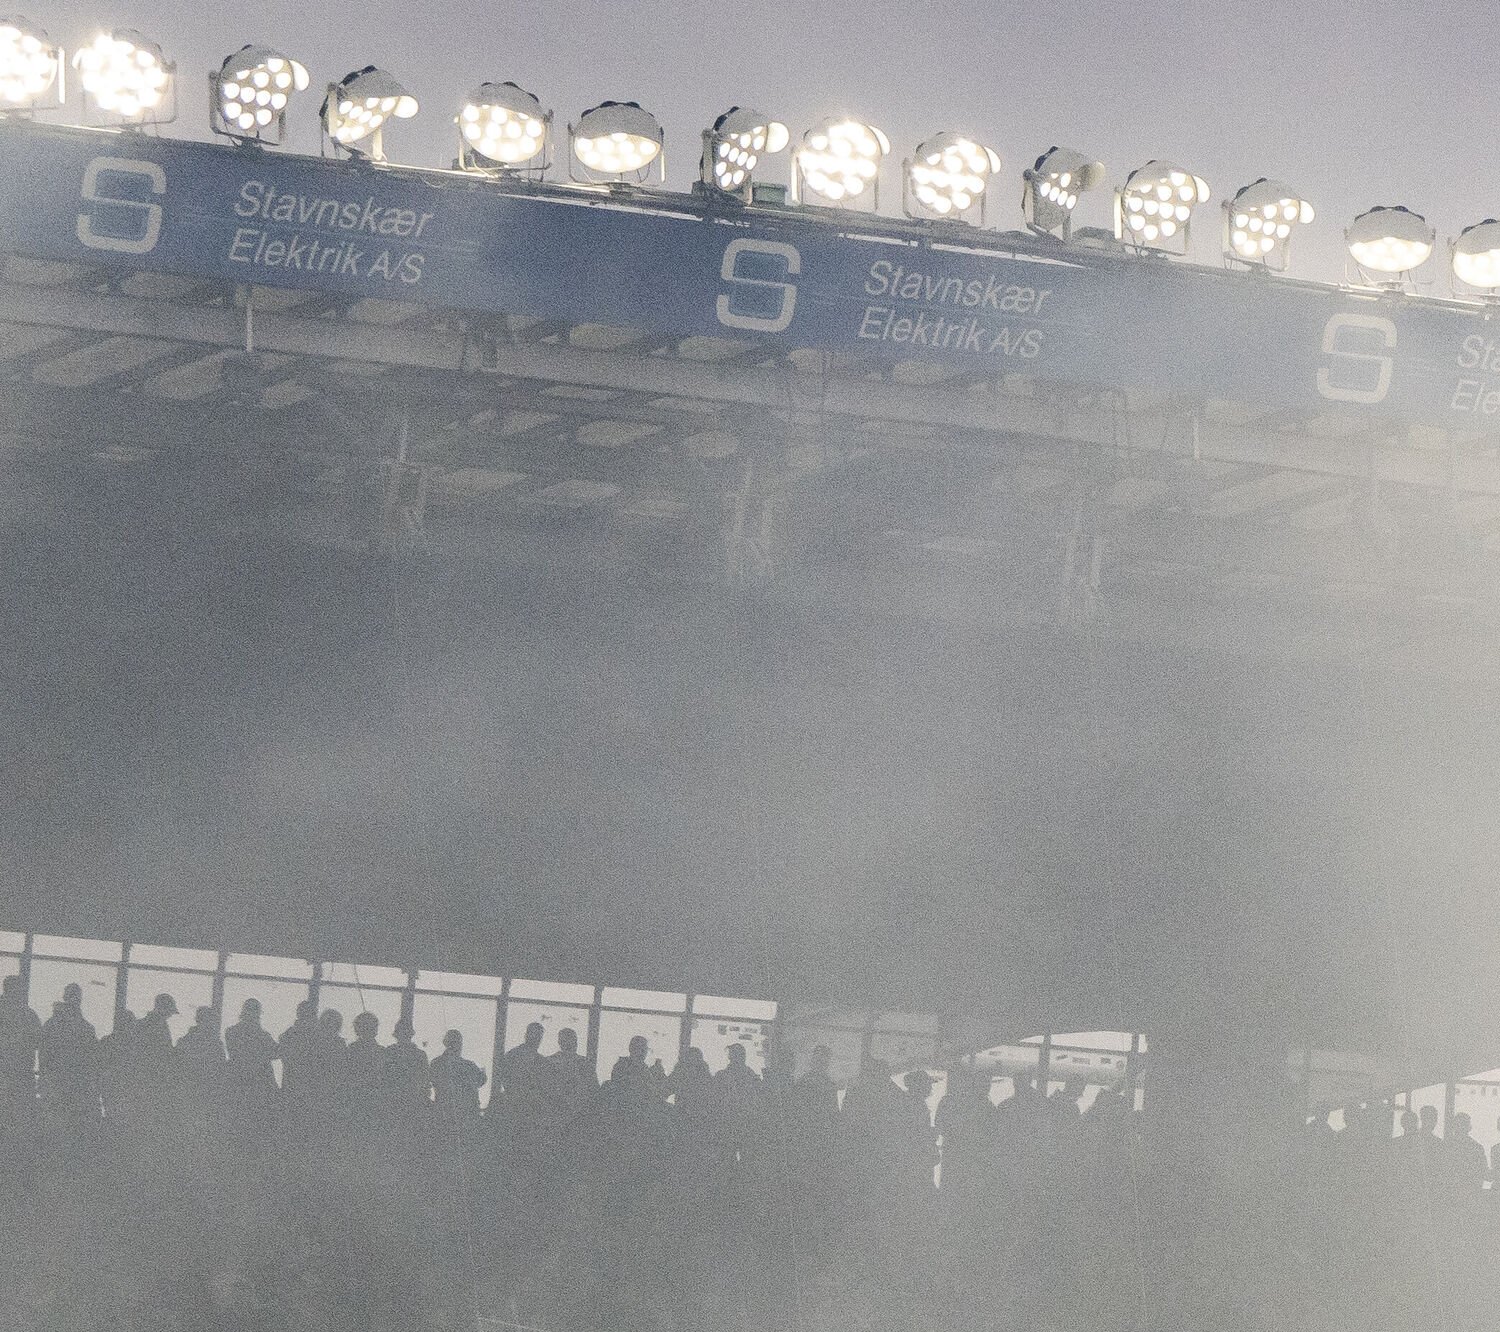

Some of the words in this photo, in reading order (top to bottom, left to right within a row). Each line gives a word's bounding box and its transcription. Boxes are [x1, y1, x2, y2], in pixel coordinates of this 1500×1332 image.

[233, 180, 434, 238] Stavnskær
[227, 228, 364, 276] Elektrik
[366, 250, 426, 284] A/S
[864, 260, 1052, 314] Stavnskær
[858, 306, 985, 352] Elektrik
[988, 327, 1046, 358] A/S
